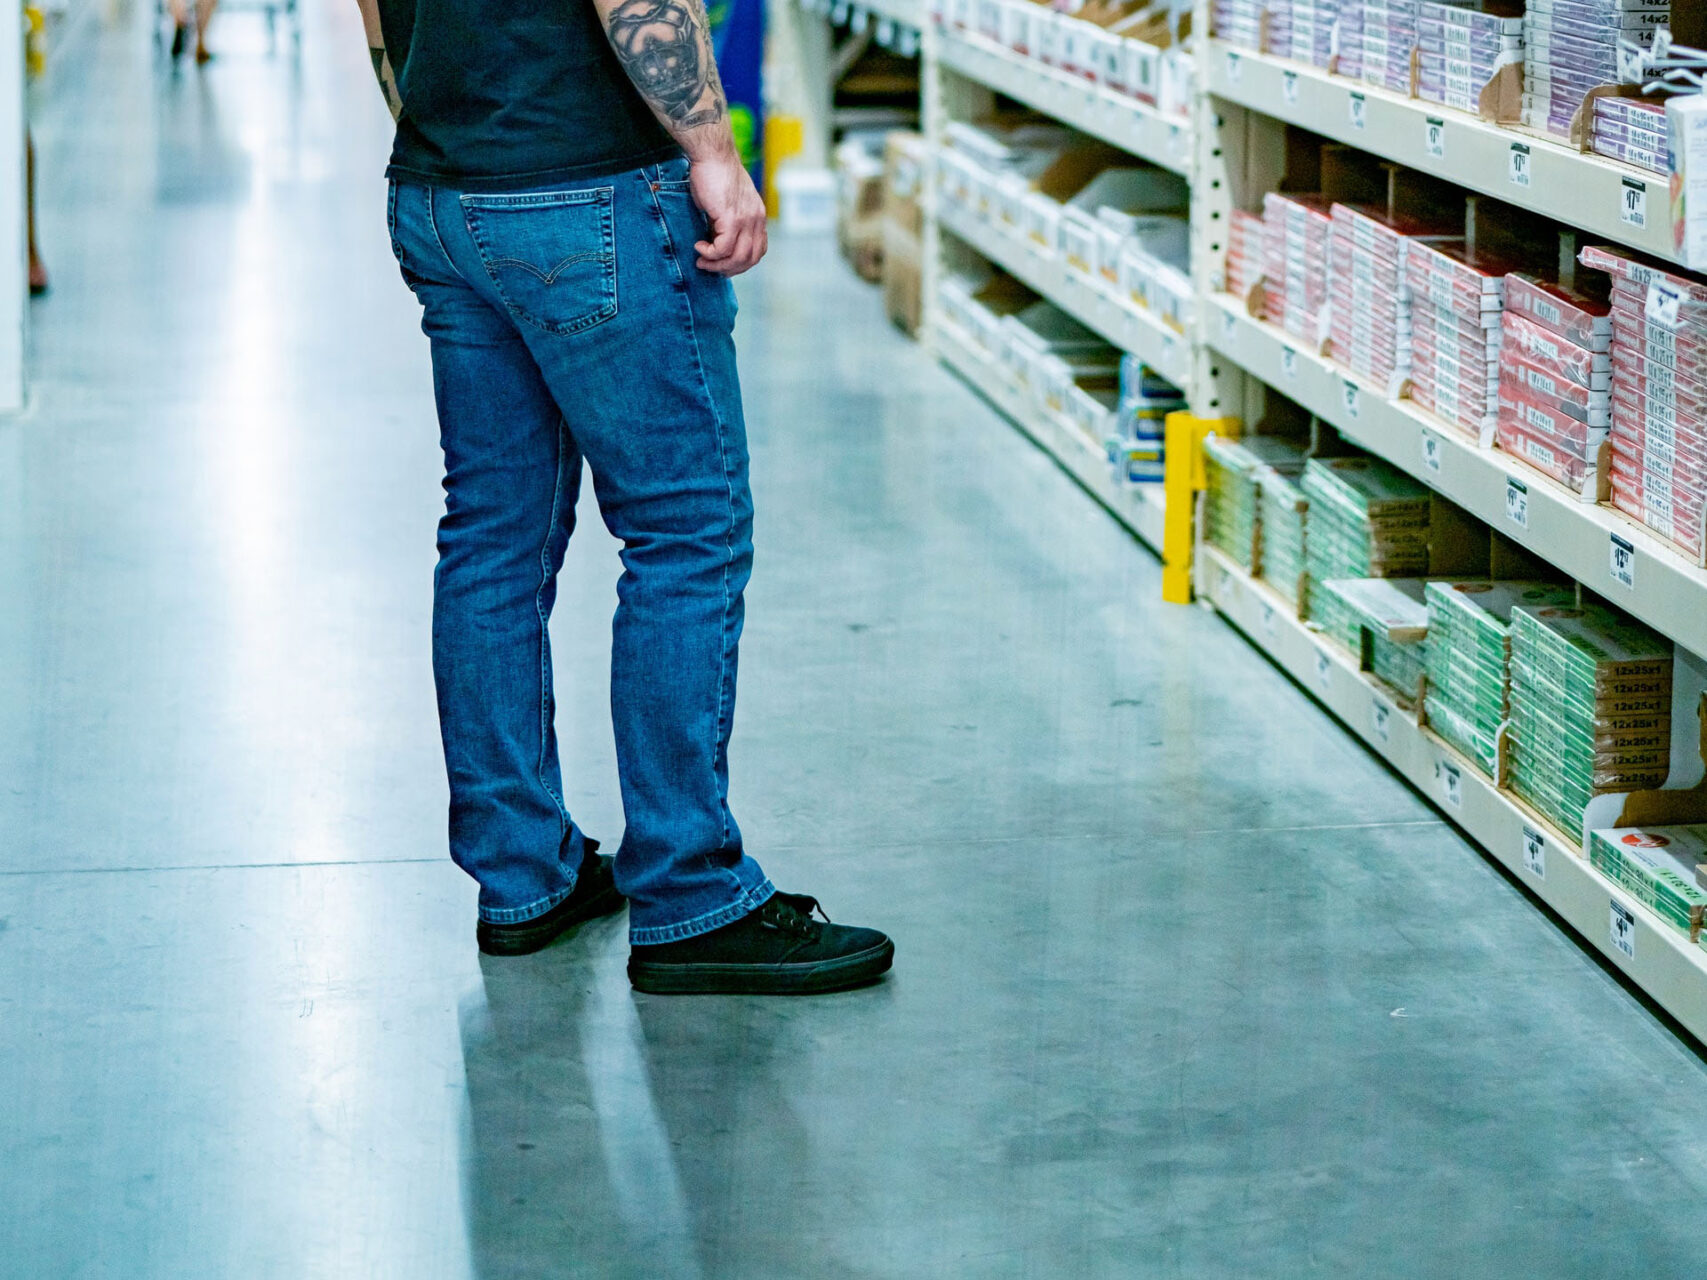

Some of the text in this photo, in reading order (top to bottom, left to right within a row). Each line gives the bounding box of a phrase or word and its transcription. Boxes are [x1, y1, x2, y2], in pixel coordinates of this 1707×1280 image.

[1615, 666, 1661, 676] 12x25x1
[1614, 683, 1661, 693] 12x25x1
[1615, 701, 1661, 711] 12x25x1
[1613, 719, 1659, 729] 12x25x1
[1615, 737, 1660, 747] 12x25x1
[1613, 755, 1658, 765] 12x25x1
